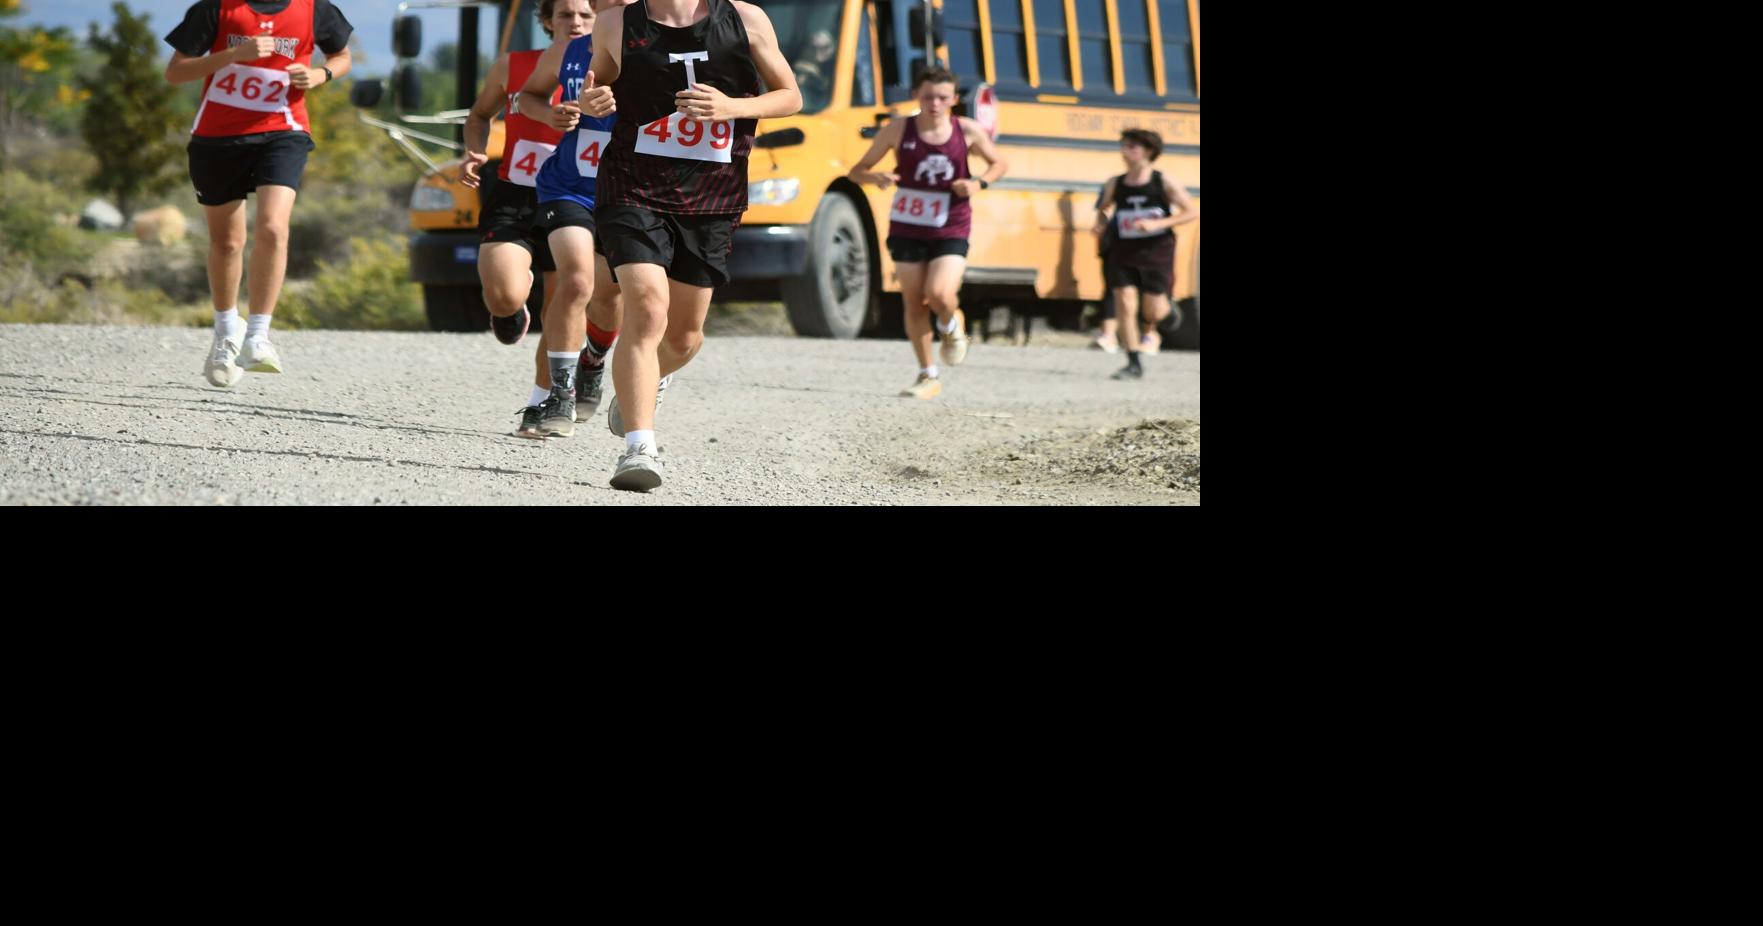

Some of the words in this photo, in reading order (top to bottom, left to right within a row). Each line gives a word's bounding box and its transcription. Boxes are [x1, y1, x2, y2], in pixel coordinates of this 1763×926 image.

[274, 37, 299, 60] ORK
[669, 51, 709, 90] T
[215, 73, 284, 102] 462
[643, 116, 731, 149] 499
[895, 195, 942, 217] 481
